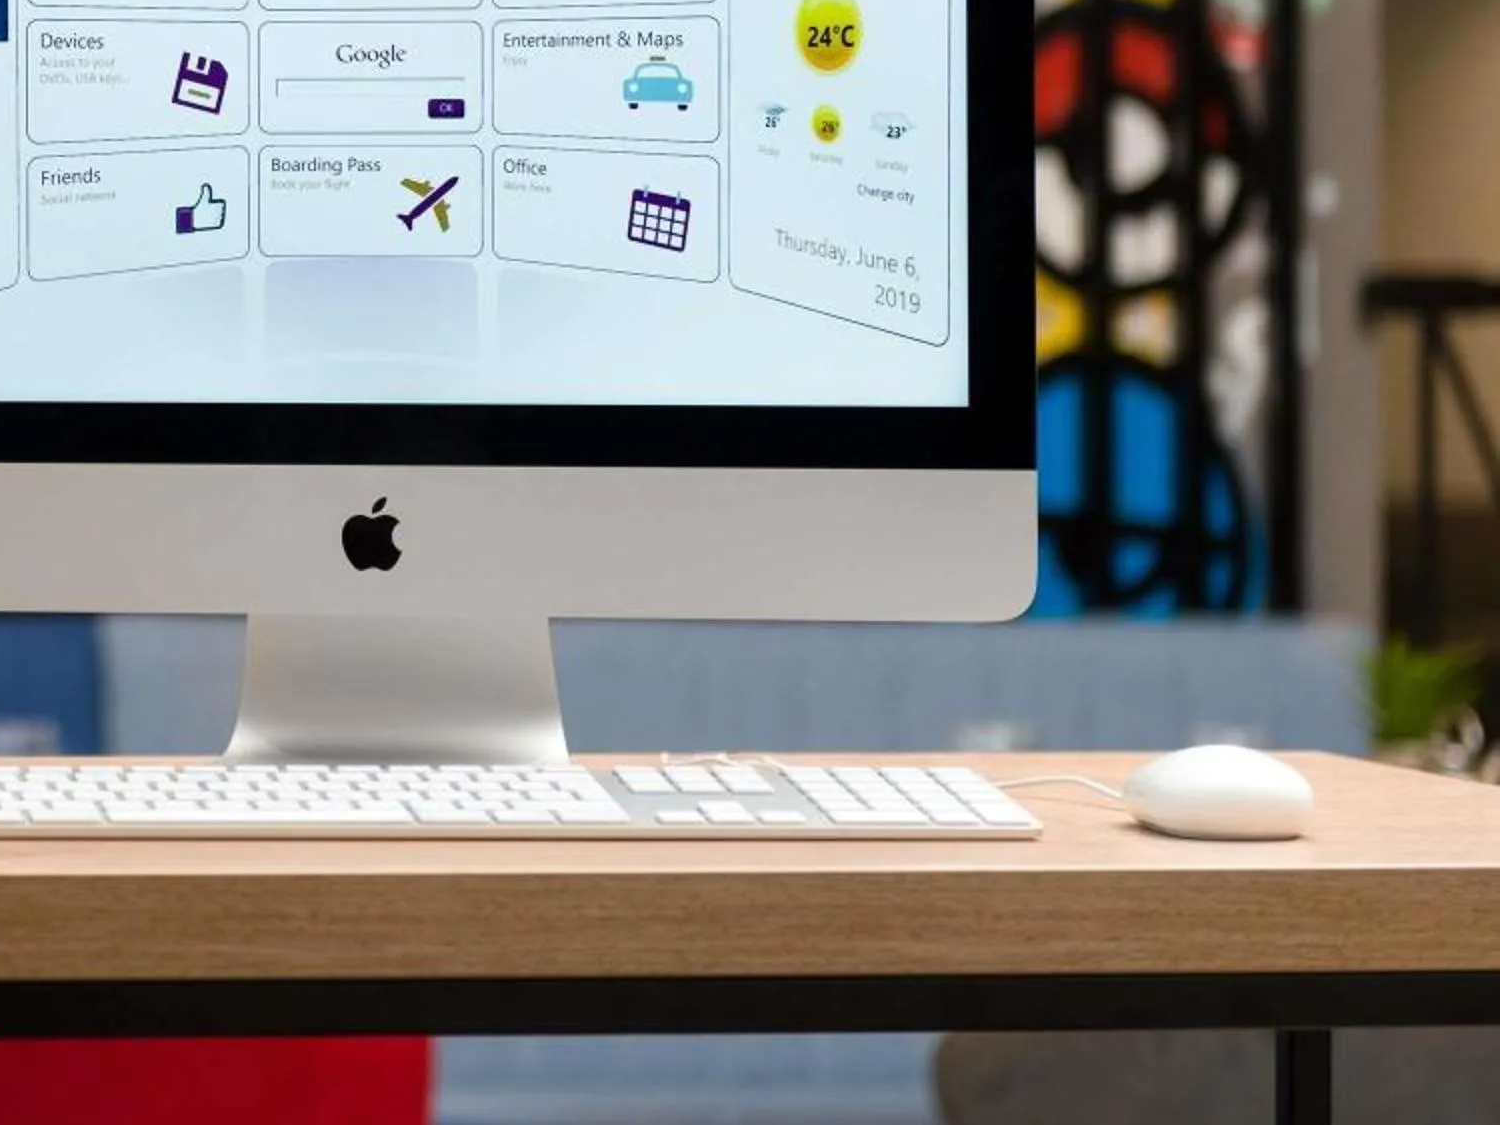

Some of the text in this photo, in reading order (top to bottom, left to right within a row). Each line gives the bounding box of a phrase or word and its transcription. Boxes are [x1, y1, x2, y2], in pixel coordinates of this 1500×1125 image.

[40, 32, 105, 49] Devices
[503, 31, 684, 50] Entertainment & Maps
[807, 25, 855, 48] 24°C
[335, 44, 408, 69] Google
[271, 157, 381, 175] Boarding Pass
[503, 158, 548, 176] Office
[41, 166, 101, 186] Friends
[897, 189, 916, 205] city
[774, 228, 921, 281] Thursday, June 6,
[875, 284, 921, 314] 2019
